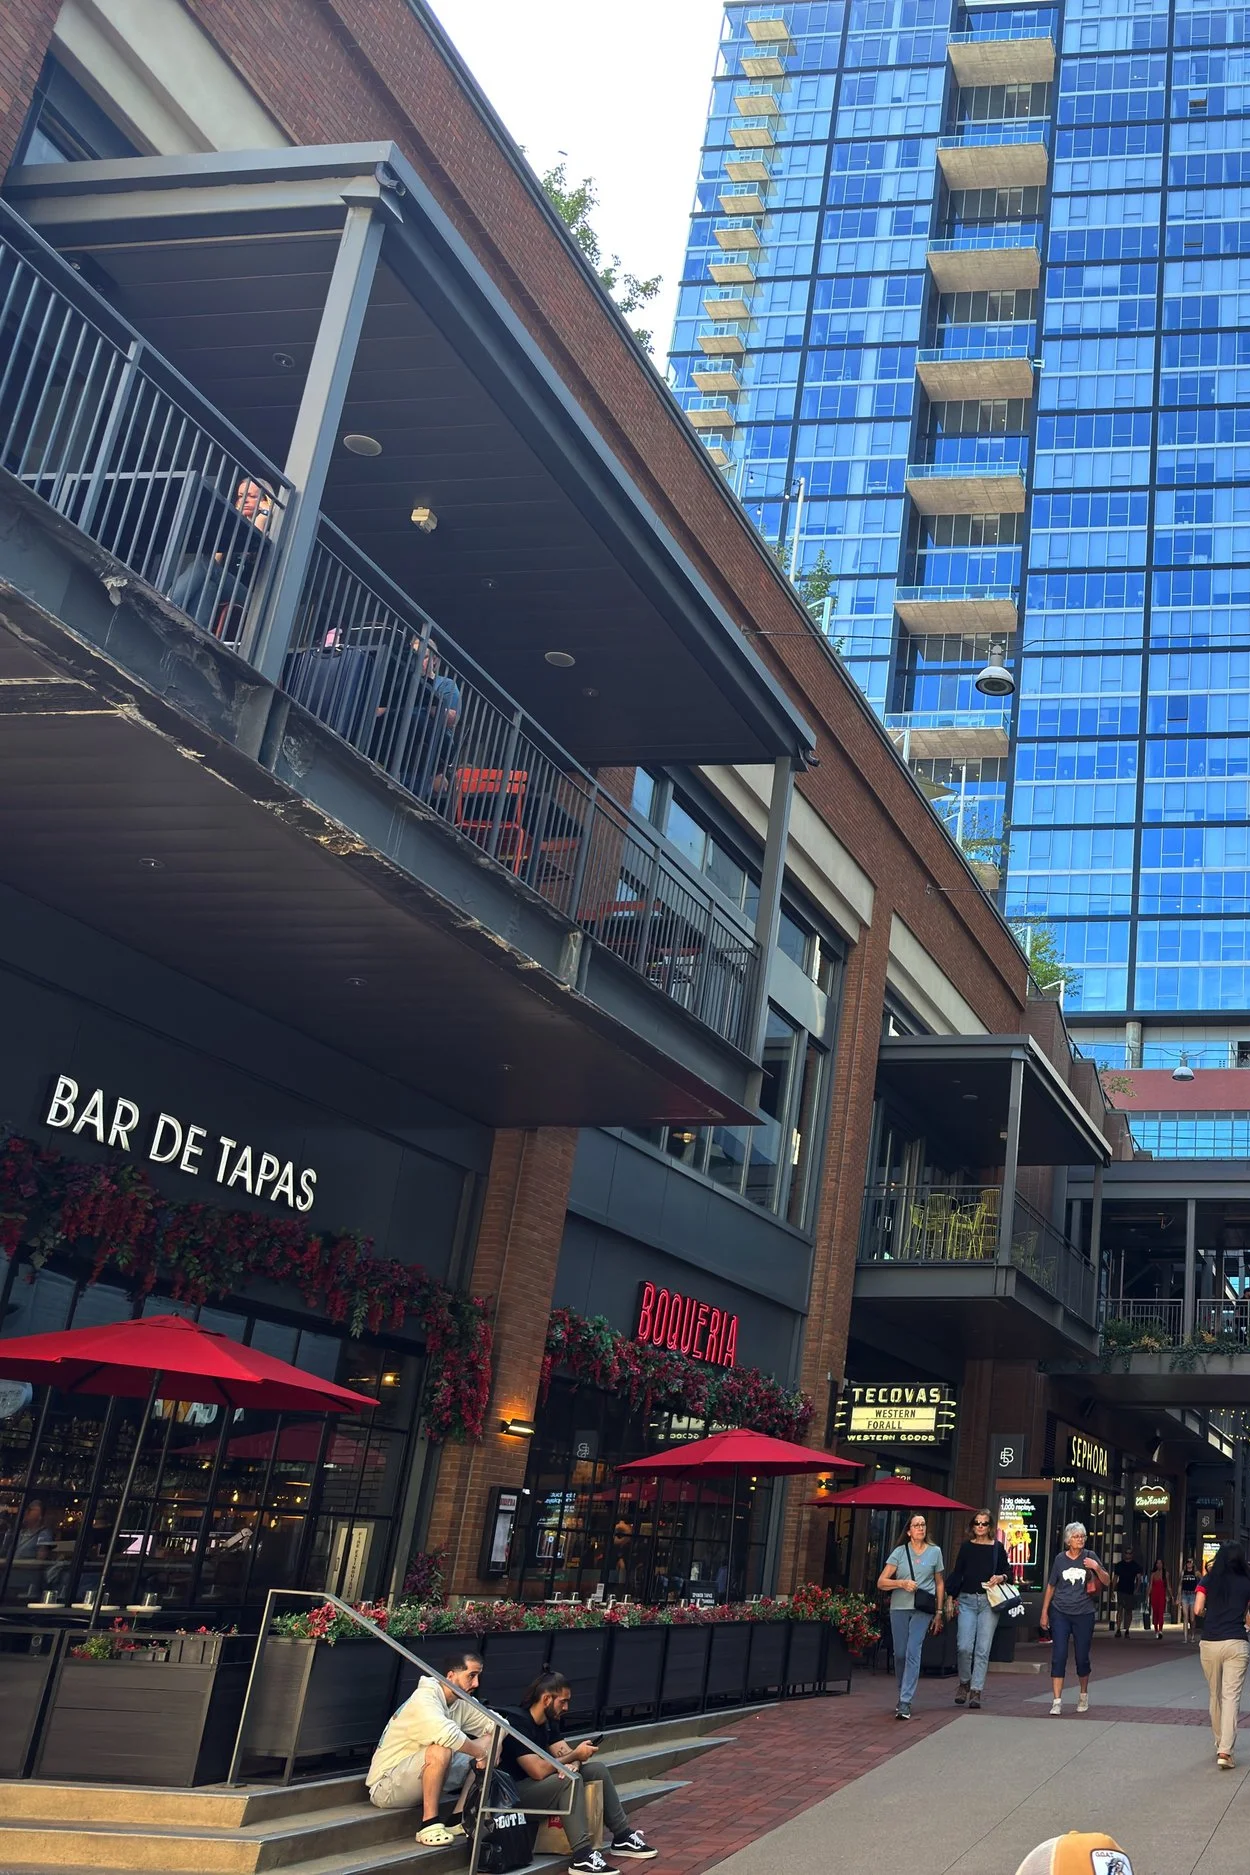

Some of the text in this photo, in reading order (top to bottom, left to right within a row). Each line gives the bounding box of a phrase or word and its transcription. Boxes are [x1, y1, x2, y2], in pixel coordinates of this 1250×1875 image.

[45, 1075, 318, 1212] BAR DE TAPAS
[638, 1281, 739, 1368] BOQUERIA
[852, 1388, 941, 1404] TECOVAS
[875, 1409, 916, 1418] WESTERN
[900, 1434, 937, 1442] GOODS
[1071, 1436, 1109, 1477] SEPHORA
